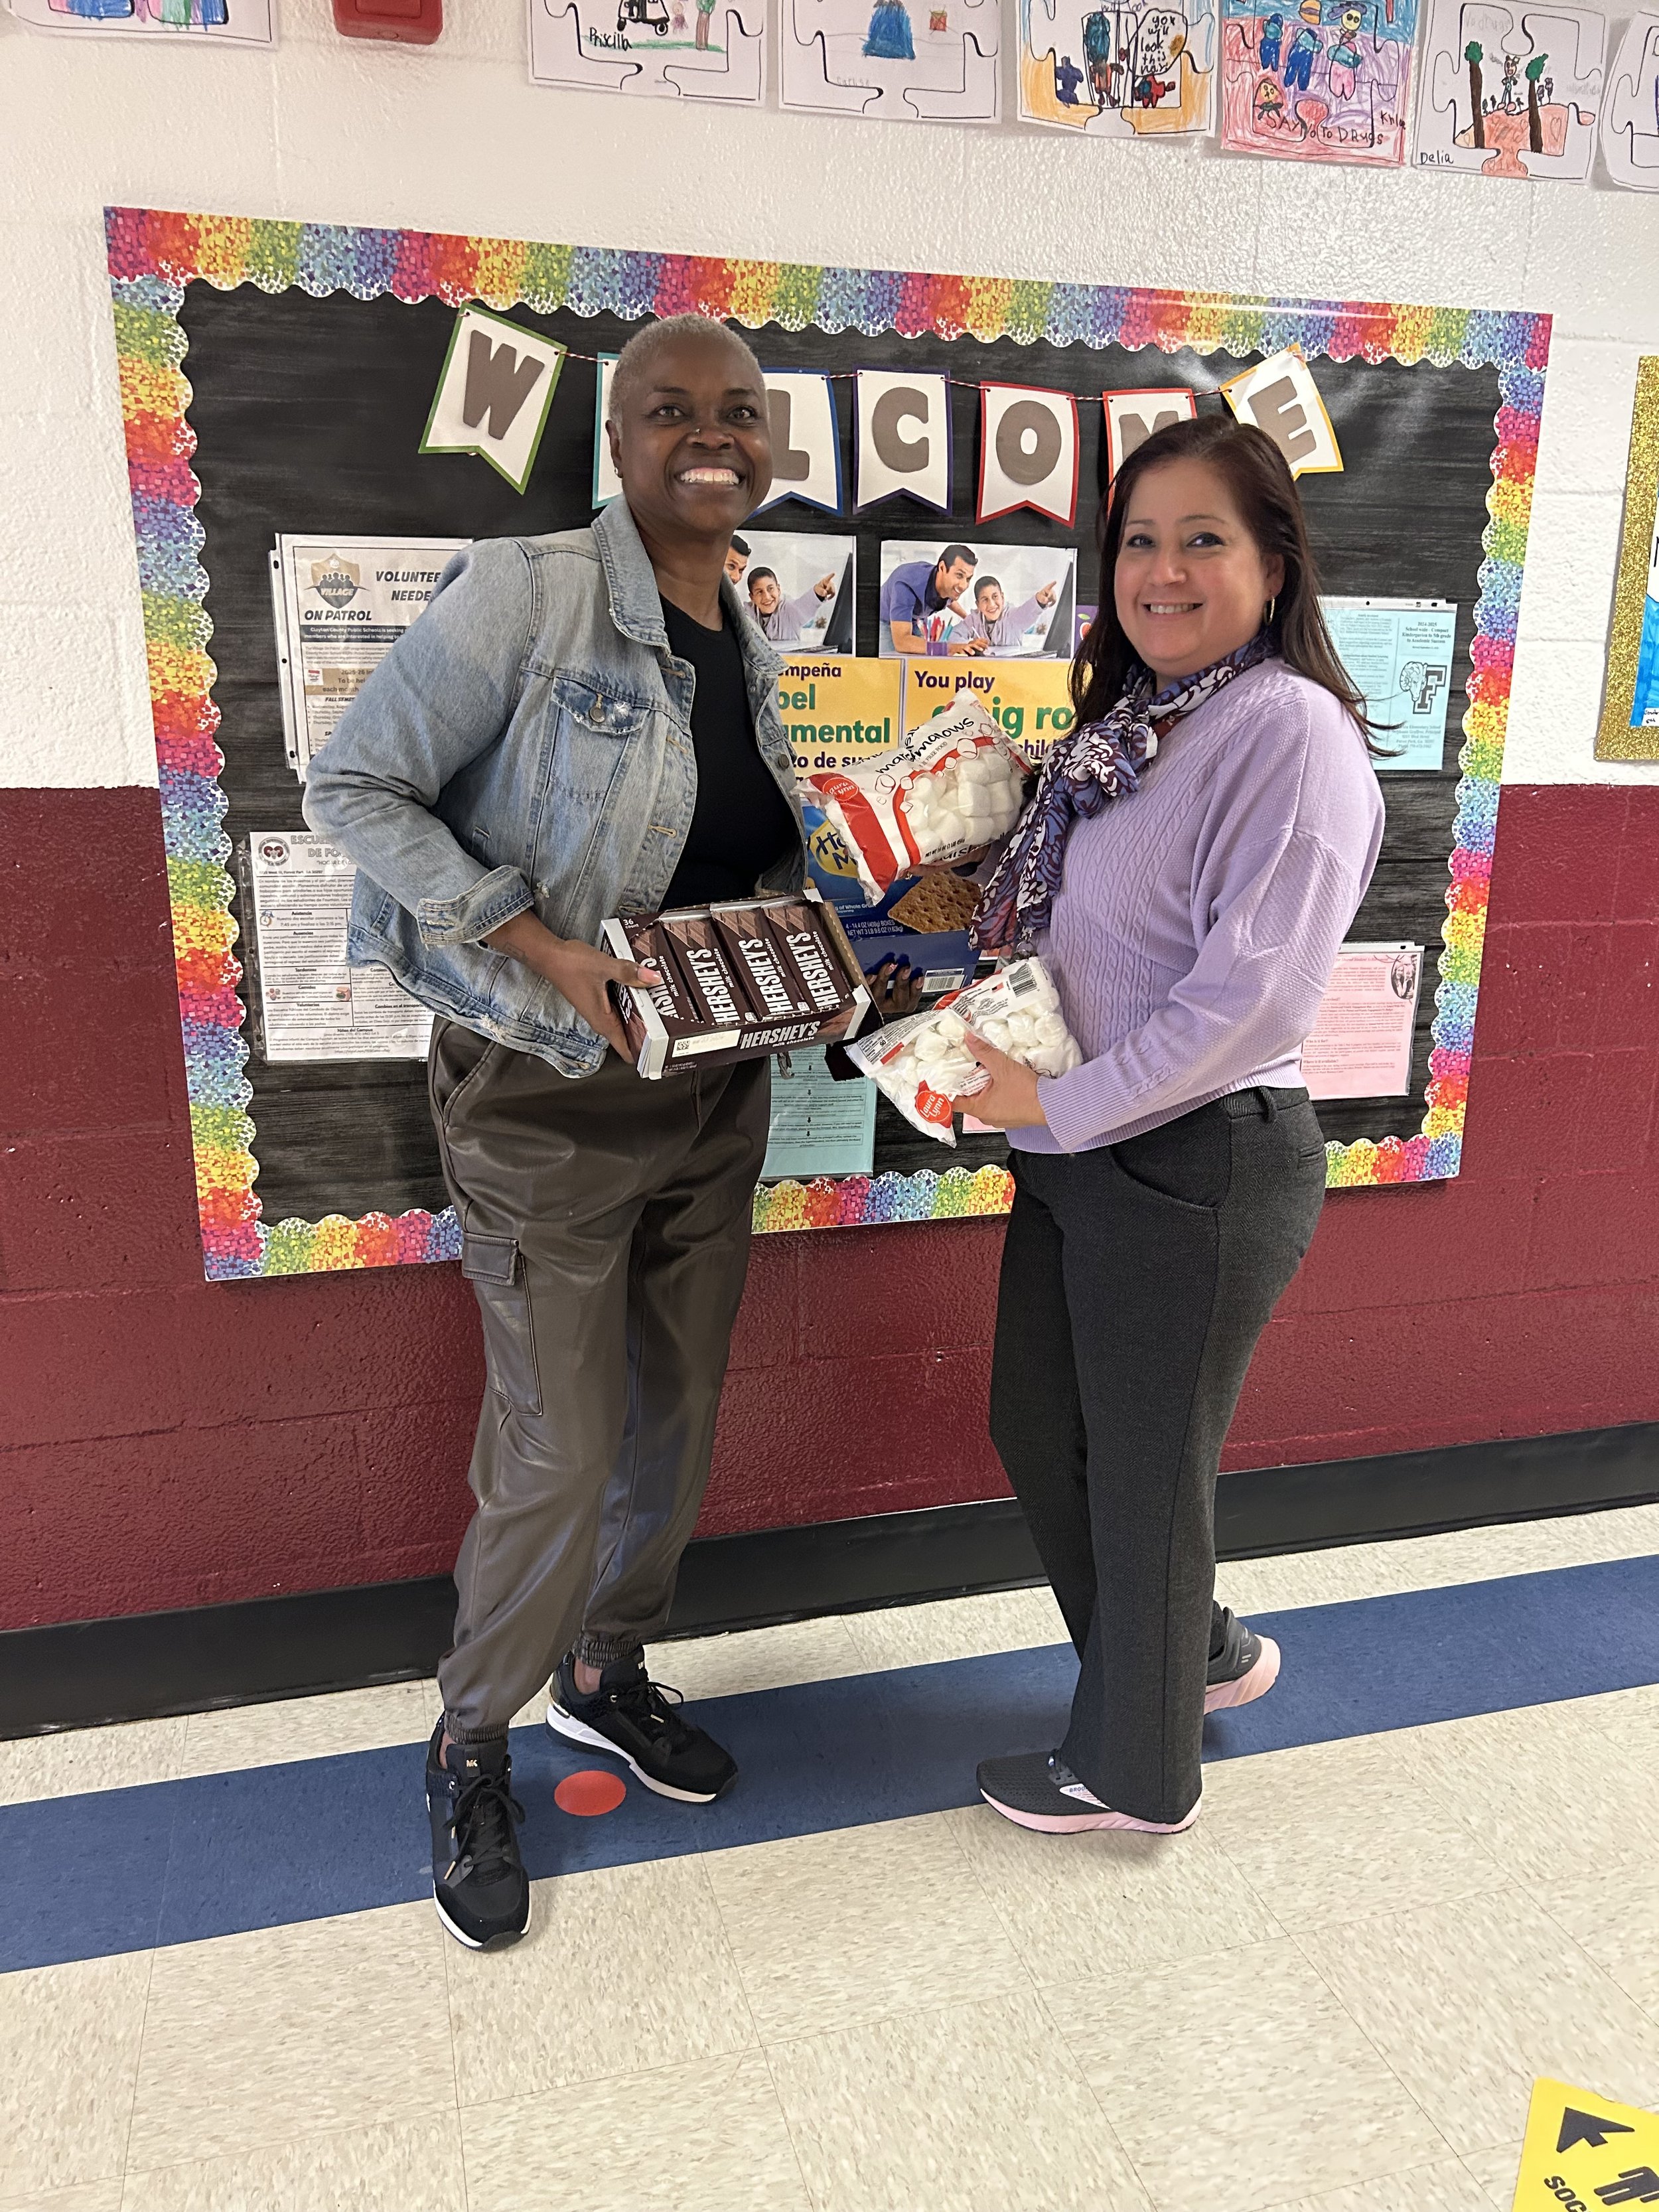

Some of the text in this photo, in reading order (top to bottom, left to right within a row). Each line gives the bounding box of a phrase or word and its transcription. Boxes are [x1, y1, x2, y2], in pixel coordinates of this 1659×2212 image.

[589, 27, 632, 51] Priscilla
[1267, 115, 1300, 132] SAY
[1420, 152, 1454, 165] Delia
[304, 610, 372, 621] ON PATROL
[778, 662, 841, 680] mpeña
[914, 671, 995, 693] You play
[784, 717, 890, 743] mental
[814, 751, 836, 768] de
[308, 848, 322, 857] DE
[764, 938, 786, 978] milk chocolate
[812, 930, 834, 971] milk chocolate
[659, 956, 680, 997] milk chocolate
[713, 948, 735, 988] milk chocolate
[738, 938, 794, 1016] HERSHEY'S
[786, 931, 841, 1010] HERSHEY'S
[686, 948, 741, 1023] HERSHEY'S
[740, 1021, 821, 1049] HERSHEY'S
[786, 1036, 814, 1045] chocolate
[919, 1094, 936, 1118] Laura
[928, 1097, 945, 1117] Lynn
